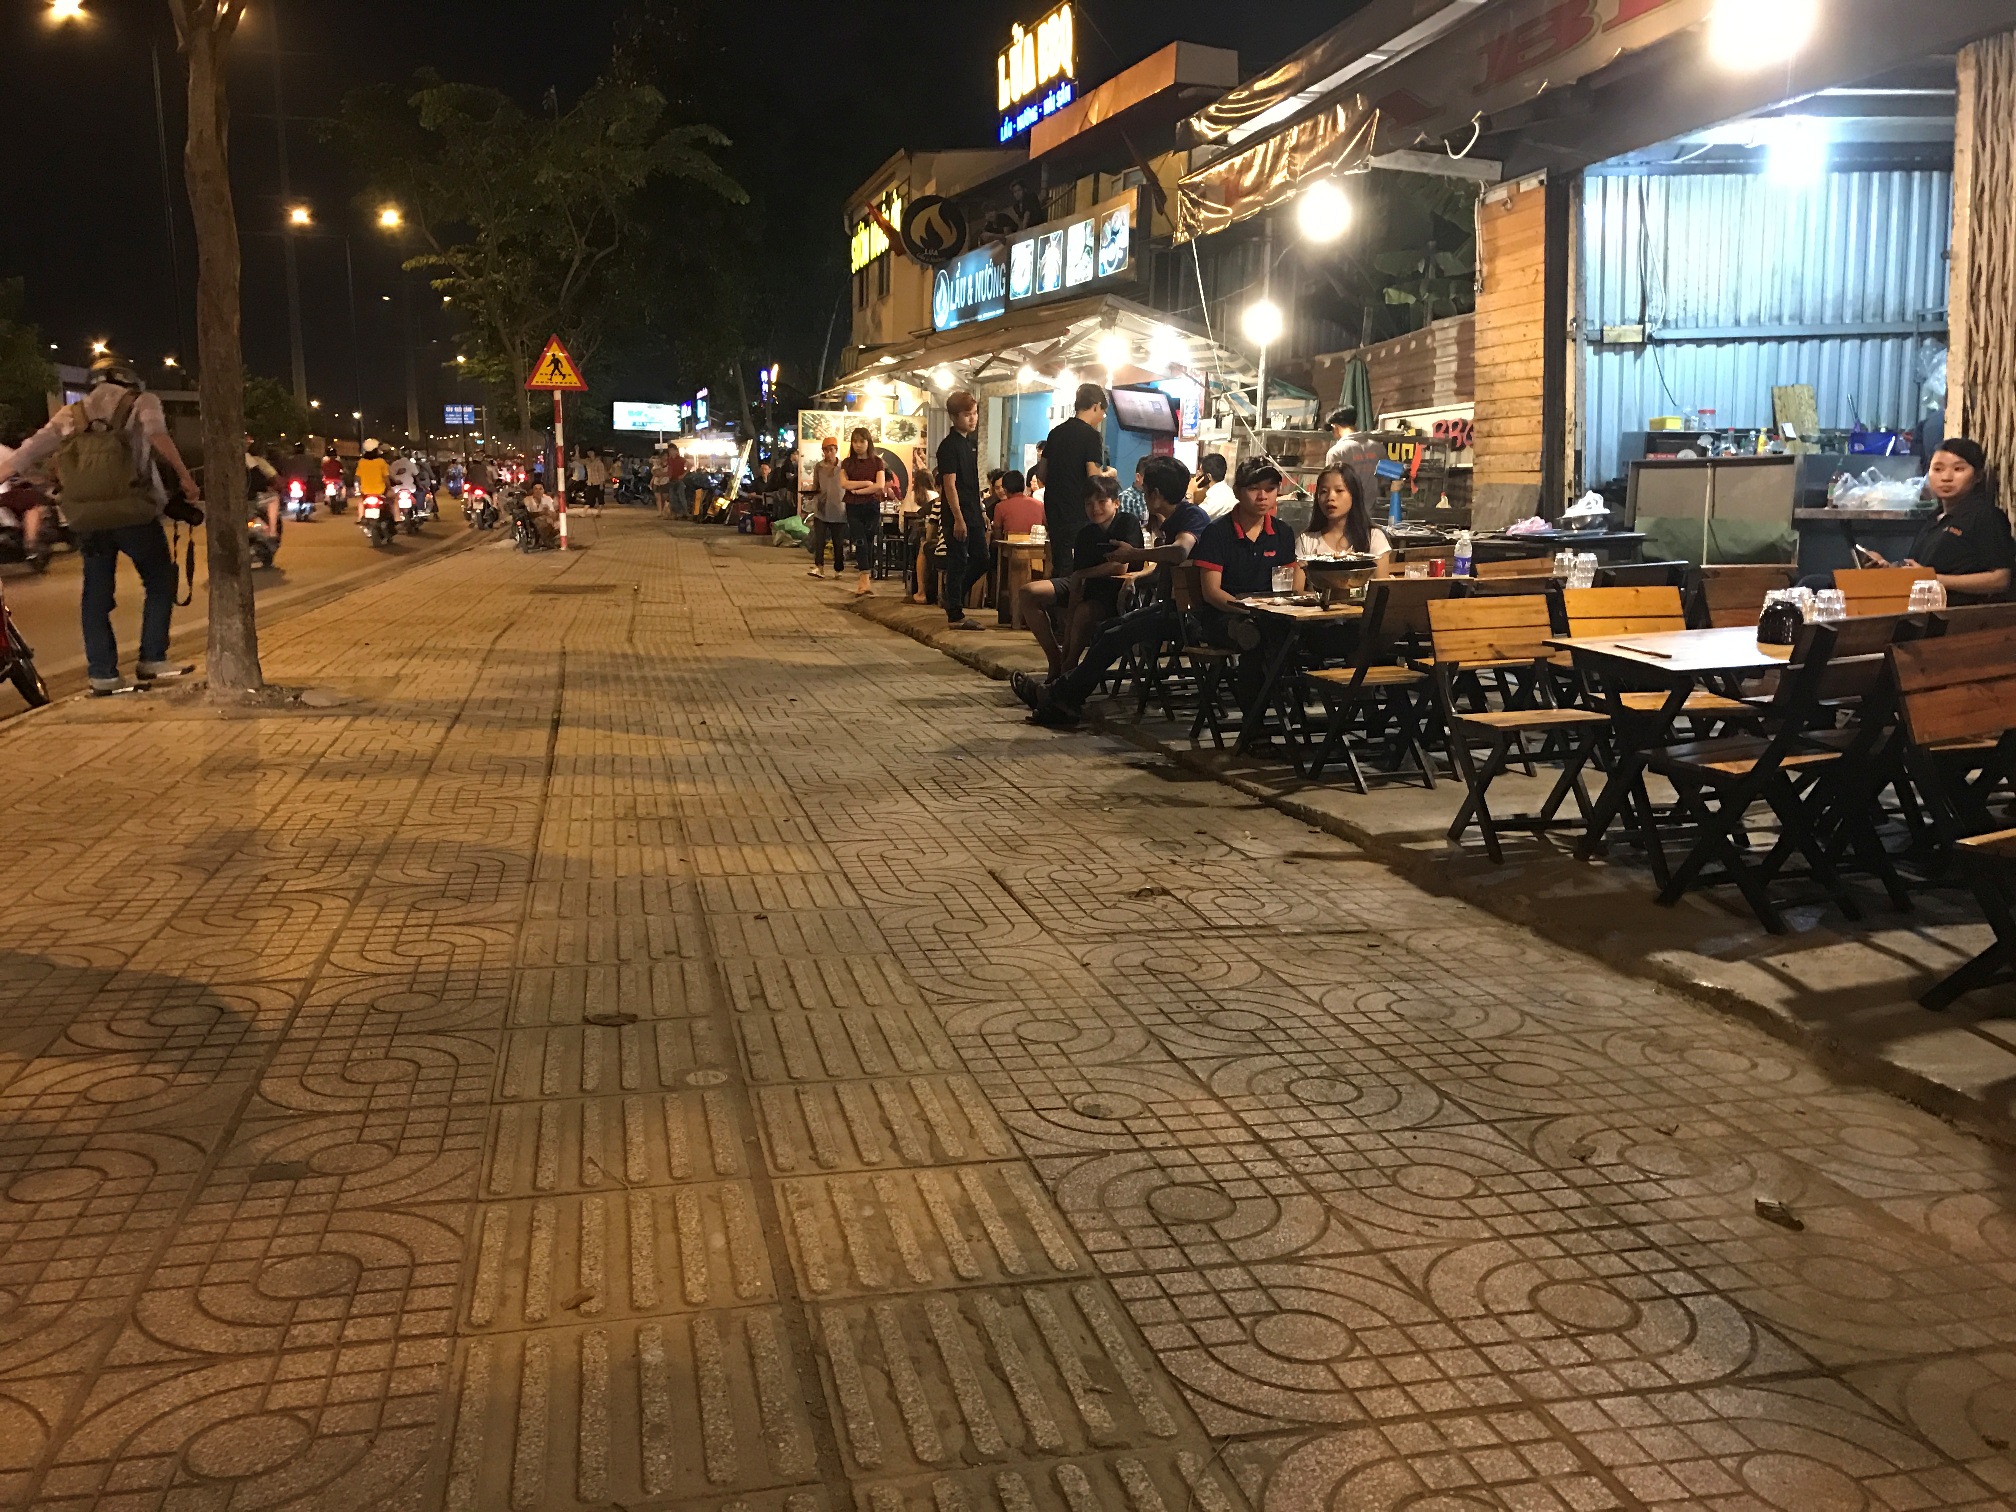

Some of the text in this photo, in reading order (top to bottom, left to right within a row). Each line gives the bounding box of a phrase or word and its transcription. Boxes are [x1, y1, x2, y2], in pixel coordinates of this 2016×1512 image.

[949, 257, 1007, 311] LẨU & NƯỚNG
